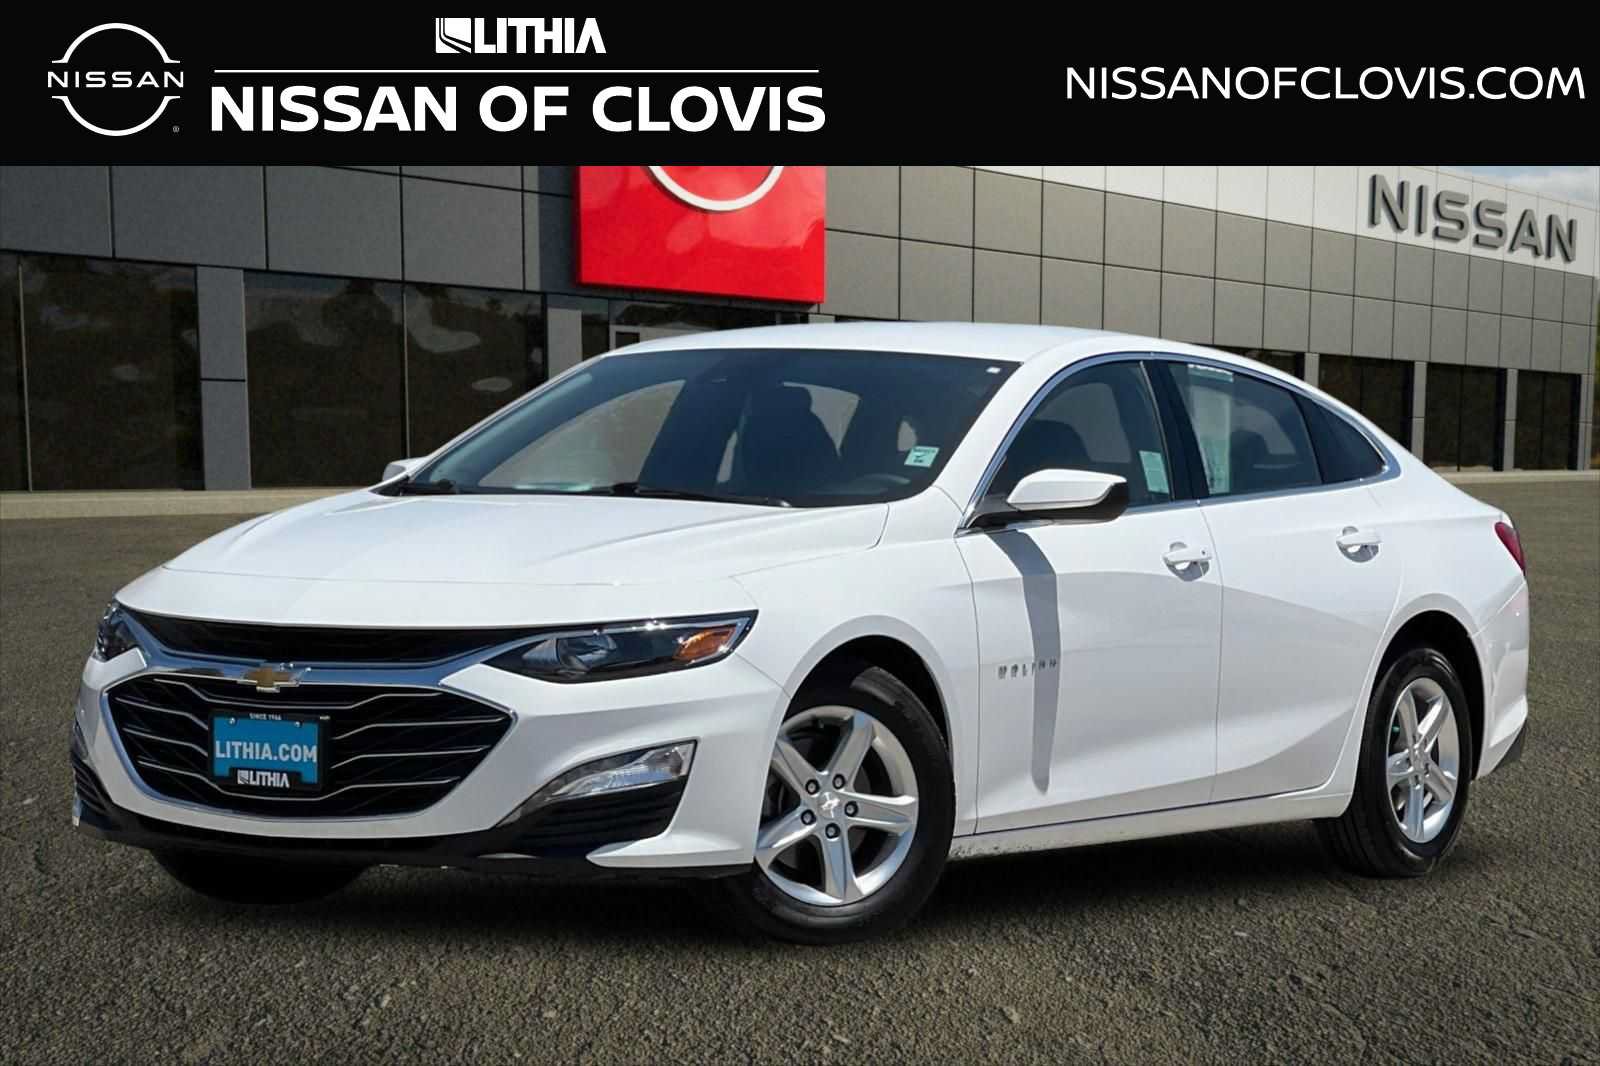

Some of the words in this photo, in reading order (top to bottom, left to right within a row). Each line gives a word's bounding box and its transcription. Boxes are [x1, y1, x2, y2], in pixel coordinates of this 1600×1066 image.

[1370, 174, 1577, 262] NISSAN
[215, 740, 317, 763] LITHIA.COM
[249, 769, 290, 788] LITHIA
